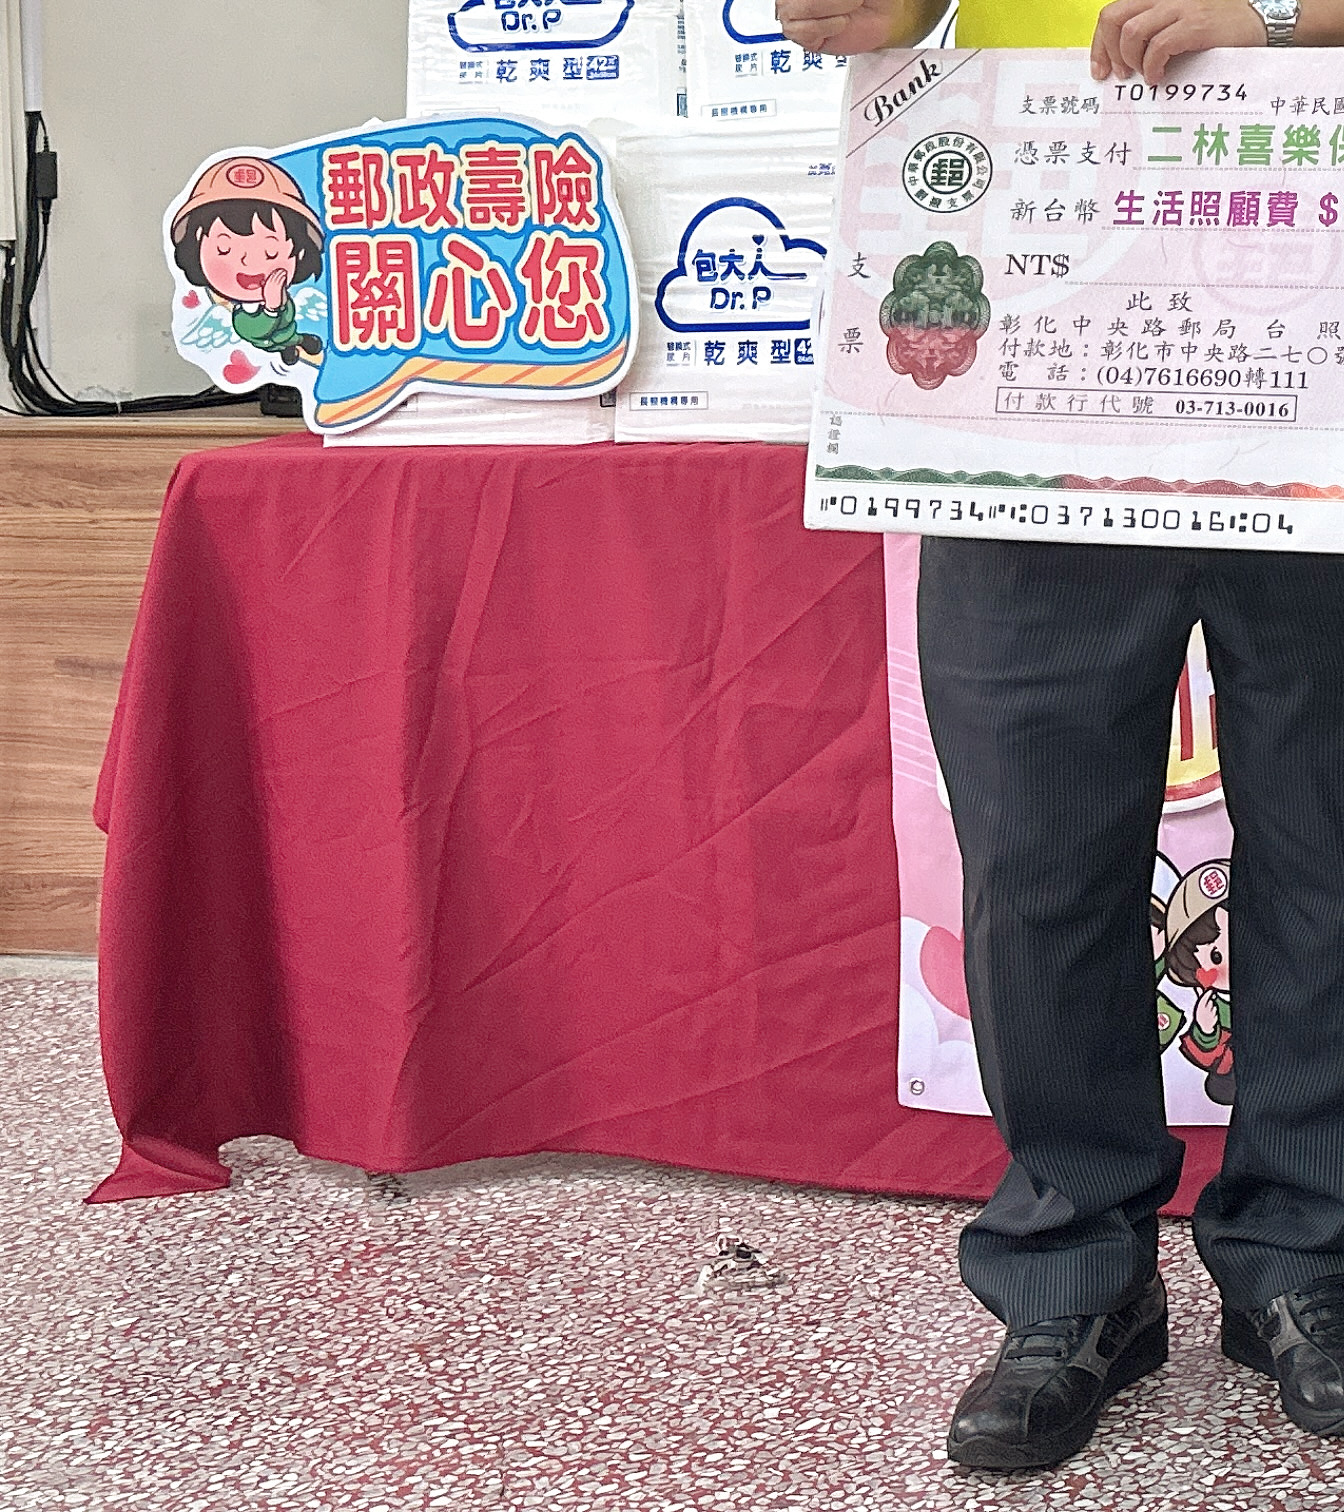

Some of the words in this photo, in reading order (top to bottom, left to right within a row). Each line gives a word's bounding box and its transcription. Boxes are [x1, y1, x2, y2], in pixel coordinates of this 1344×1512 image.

[500, 10, 538, 32] Dr.
[542, 8, 562, 31] P
[863, 58, 943, 128] Bank
[1018, 95, 1100, 116] 支票號碼
[326, 144, 598, 229] 郵政壽險
[1009, 197, 1102, 226] 新台幣
[1112, 189, 1299, 228] 生活照顧費
[691, 248, 808, 283] 包大人
[1003, 252, 1071, 279] NT$
[334, 236, 605, 346] 關心您
[709, 288, 746, 310] Dr.
[752, 286, 772, 310] P
[1125, 291, 1194, 313] 此致
[703, 338, 792, 366] 乾爽型
[1174, 399, 1291, 419] 03-713-0016
